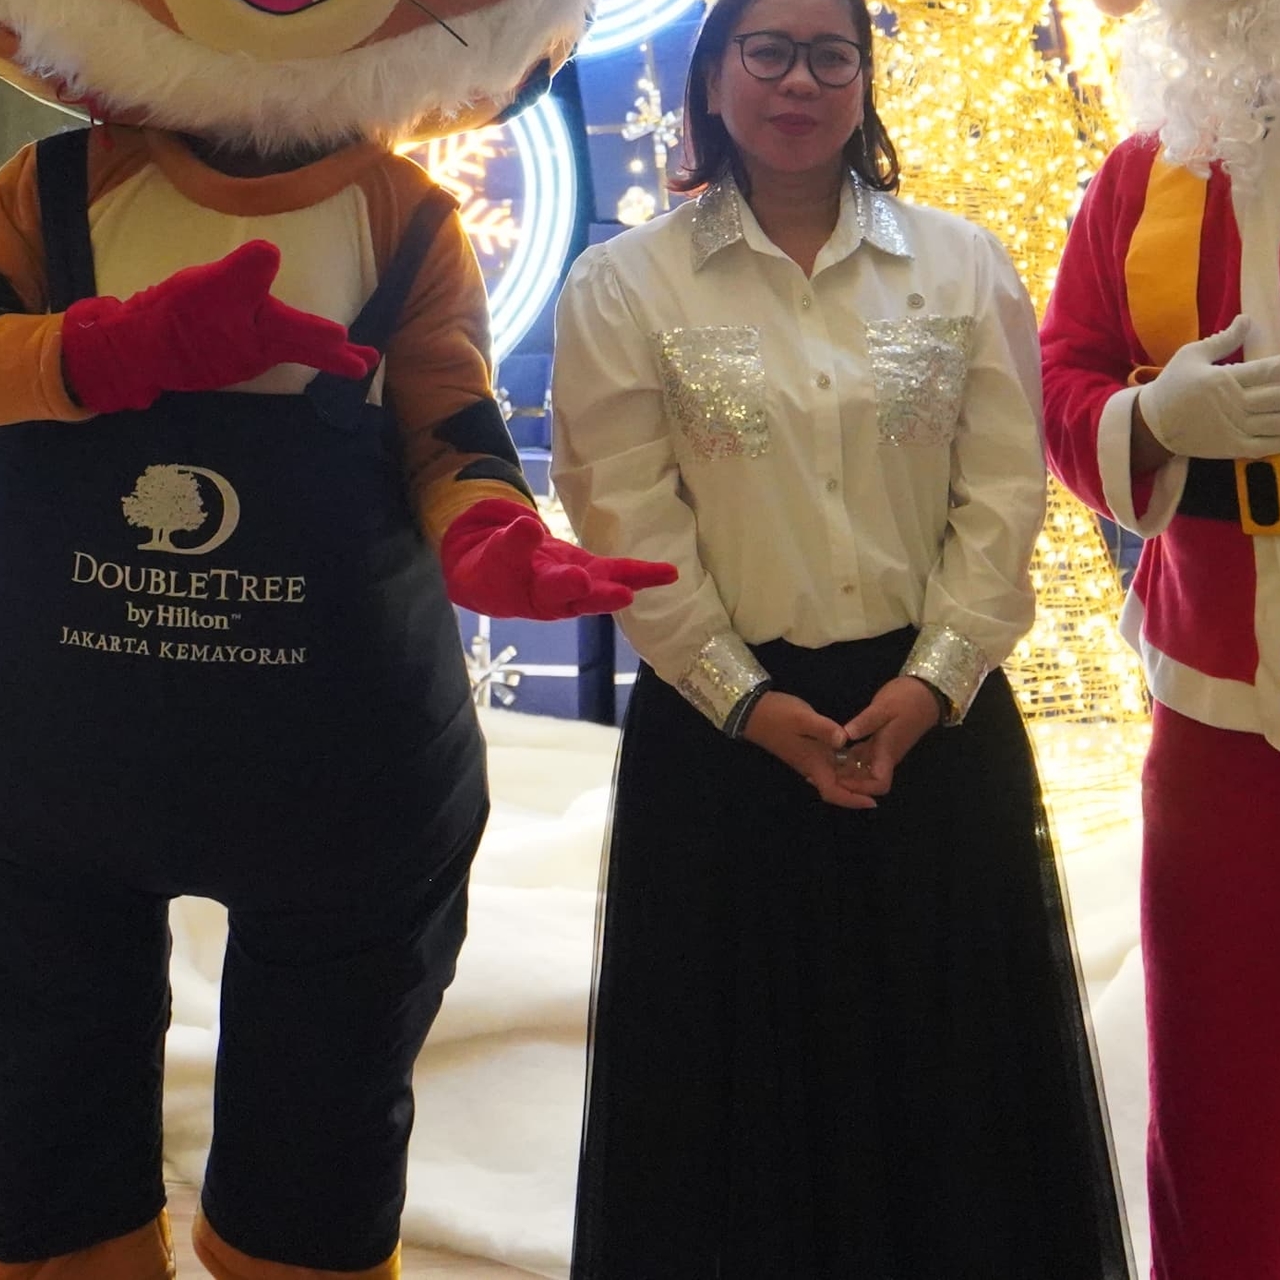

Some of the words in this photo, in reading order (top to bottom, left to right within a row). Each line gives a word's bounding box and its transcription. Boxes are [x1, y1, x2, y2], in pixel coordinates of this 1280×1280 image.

[72, 551, 306, 603] DOUBLETREE
[126, 601, 153, 629] by
[60, 626, 150, 656] JAKARTA
[159, 641, 307, 665] KEMAYORAN
